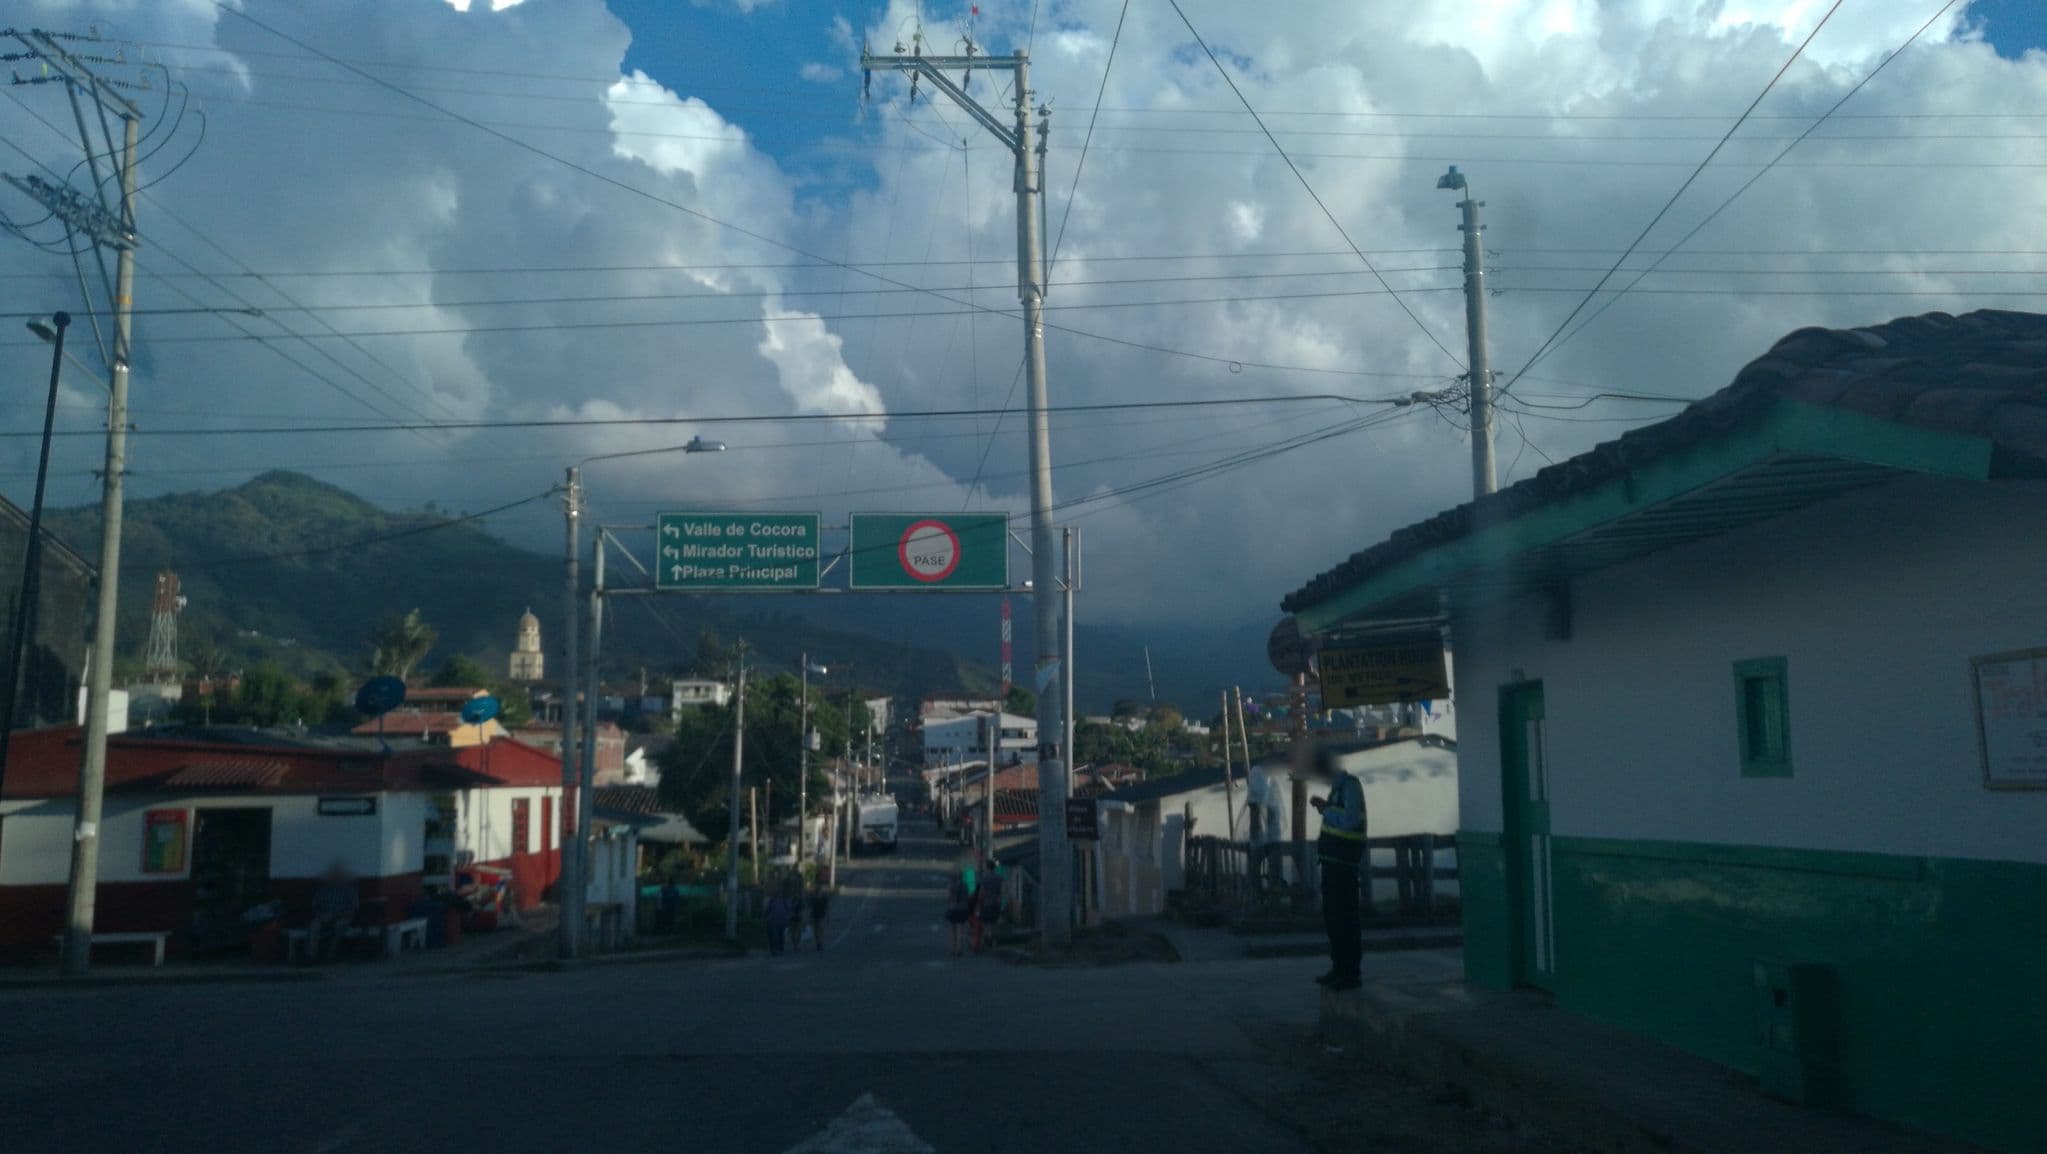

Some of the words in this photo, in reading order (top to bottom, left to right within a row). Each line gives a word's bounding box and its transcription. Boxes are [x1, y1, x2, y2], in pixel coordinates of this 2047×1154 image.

[683, 522, 722, 537] Valle
[726, 522, 745, 537] de
[750, 522, 806, 537] Cocora
[682, 544, 743, 558] Mirador
[914, 555, 945, 566] PASE
[729, 565, 798, 581] Principal
